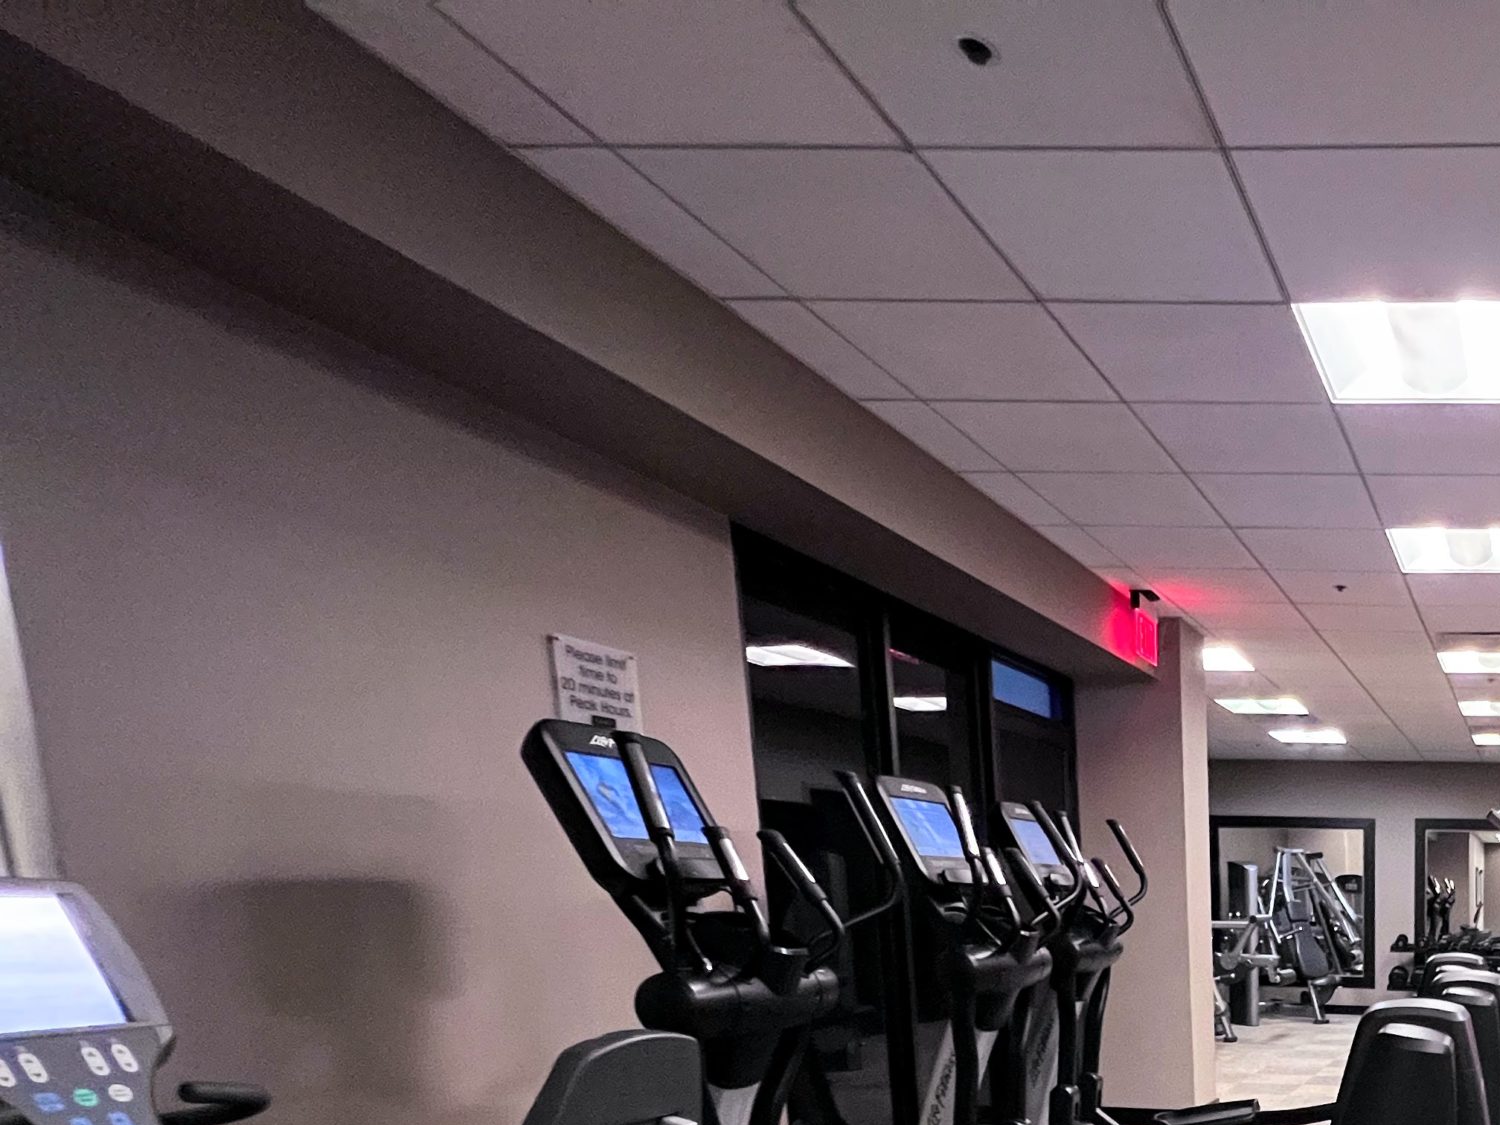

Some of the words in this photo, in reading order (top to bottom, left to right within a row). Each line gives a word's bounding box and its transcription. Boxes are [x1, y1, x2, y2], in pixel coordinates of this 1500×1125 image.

[565, 644, 602, 665] Please
[579, 664, 604, 681] time
[606, 671, 618, 684] to
[561, 676, 576, 691] 20
[579, 682, 621, 700] minutes
[569, 694, 598, 711] Peak
